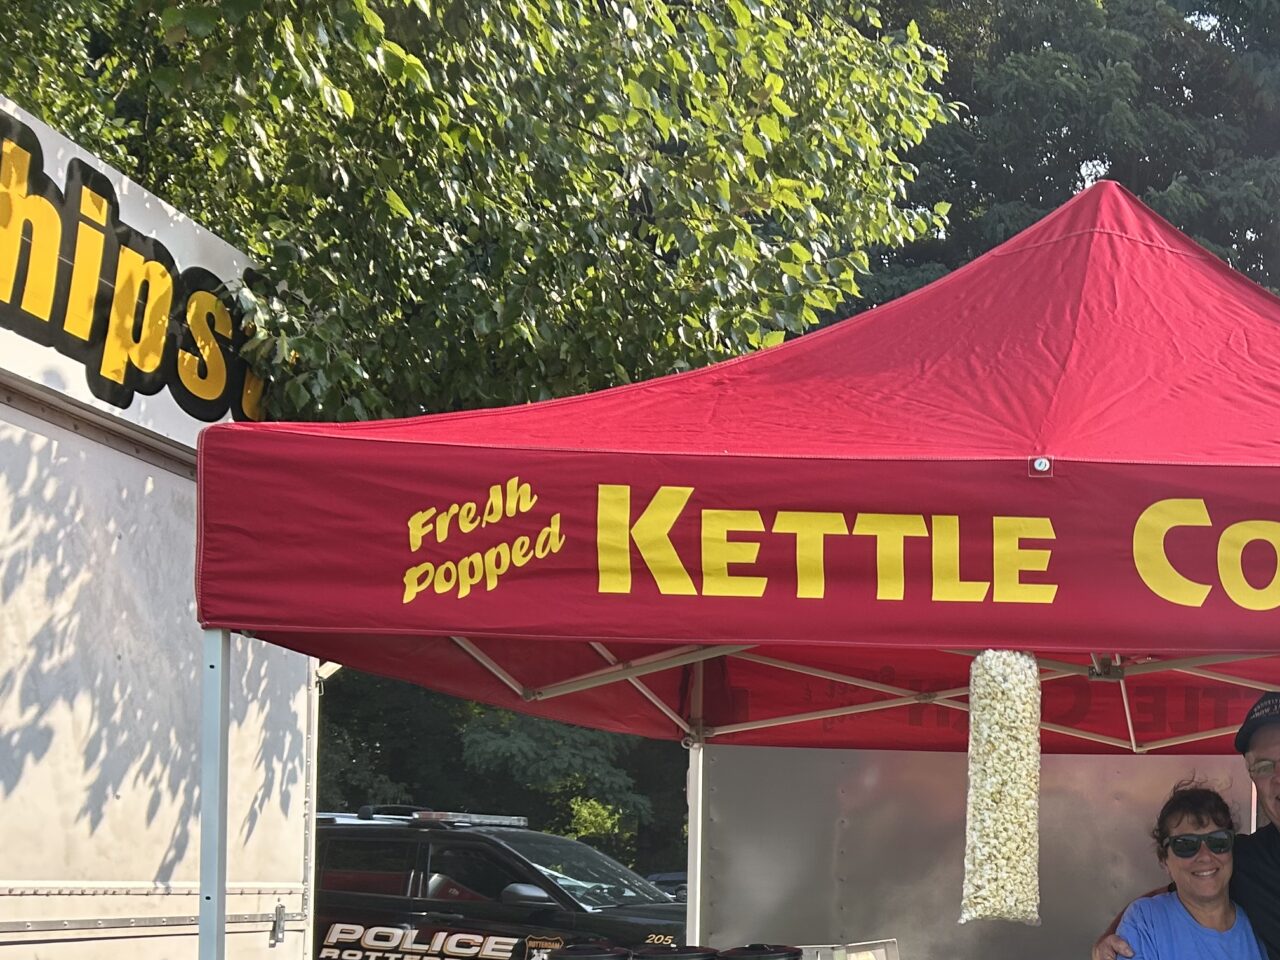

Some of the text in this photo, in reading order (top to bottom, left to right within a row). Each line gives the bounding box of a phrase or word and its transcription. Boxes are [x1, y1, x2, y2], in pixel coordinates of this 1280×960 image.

[0, 138, 267, 420] hips
[407, 476, 538, 552] Fresh
[597, 484, 1059, 604] KETTLE
[323, 923, 519, 960] POLICE
[645, 934, 674, 945] 205
